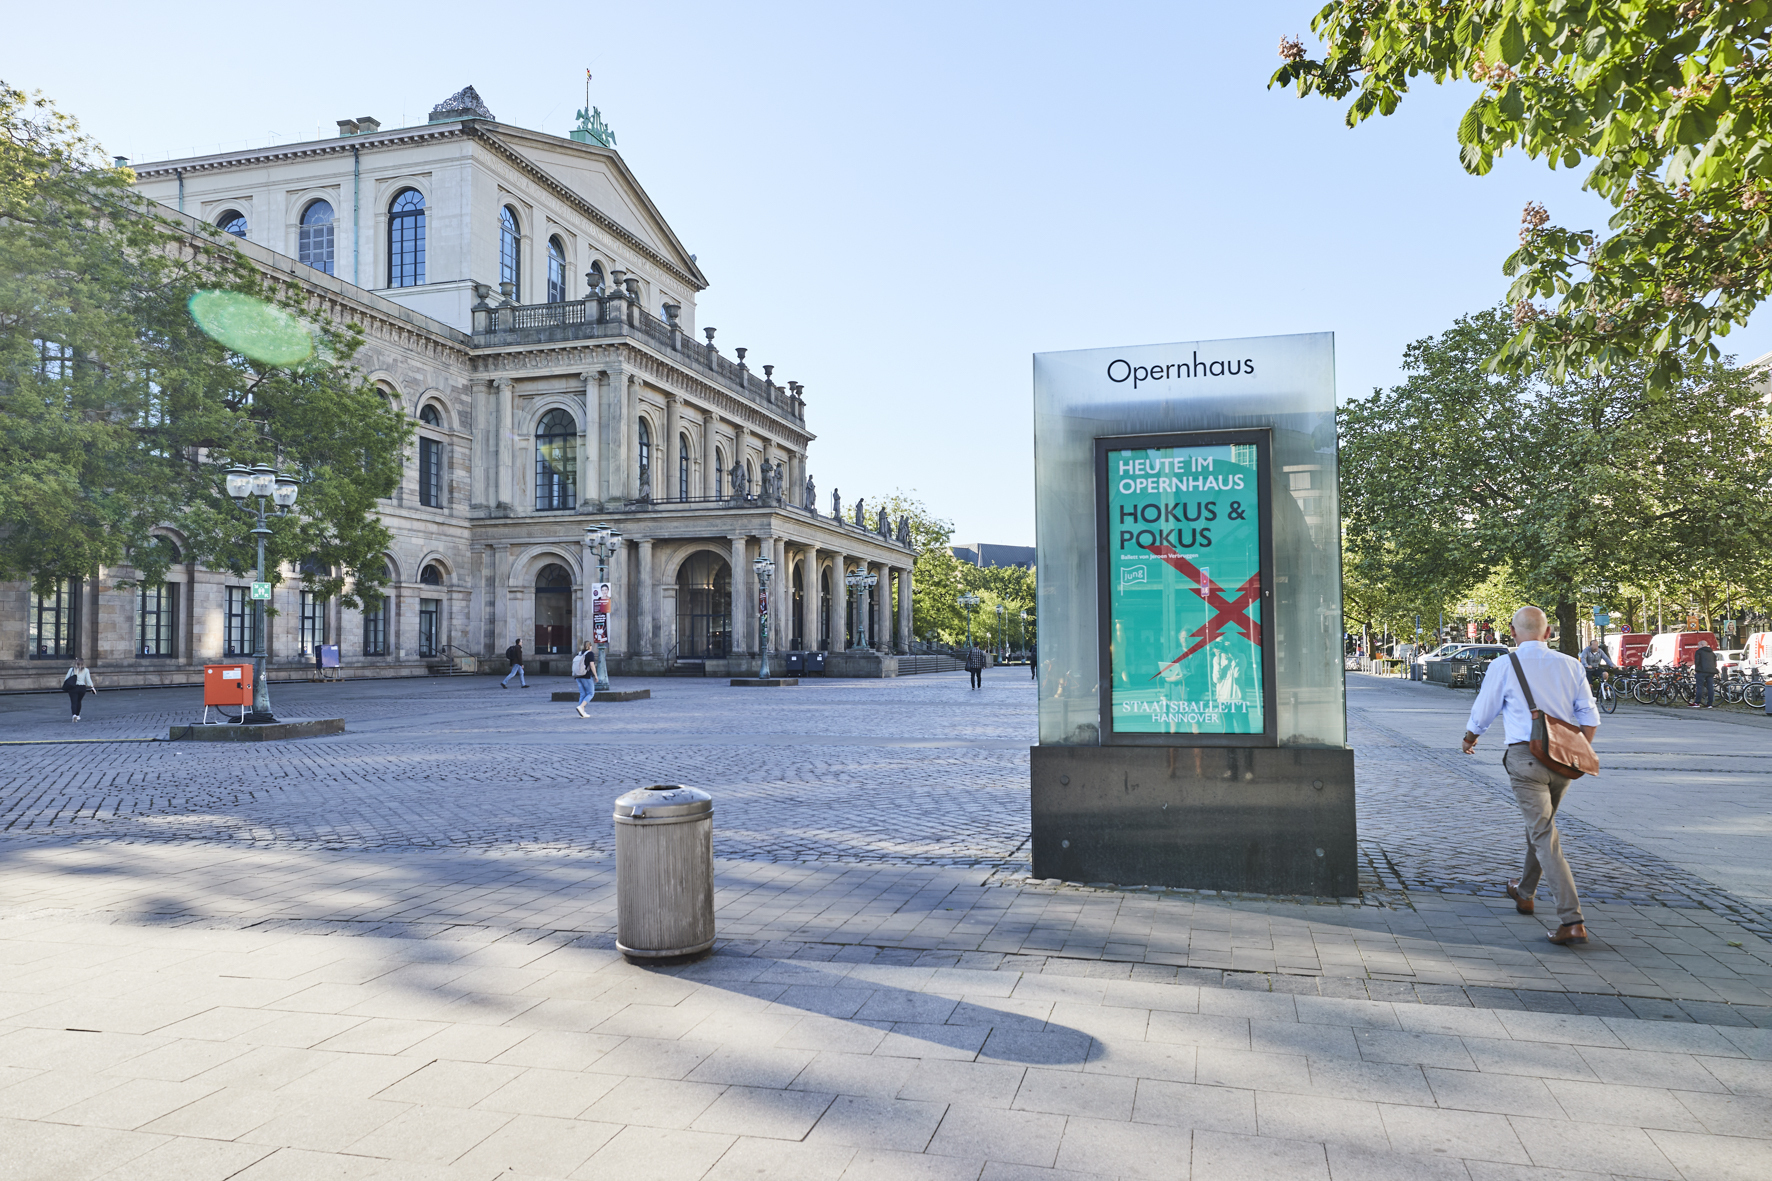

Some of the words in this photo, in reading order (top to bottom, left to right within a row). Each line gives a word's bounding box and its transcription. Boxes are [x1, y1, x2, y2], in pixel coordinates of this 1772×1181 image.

[1107, 351, 1254, 389] Opernhaus
[1119, 458, 1184, 475] HEUTE
[1192, 456, 1213, 472] IM
[1119, 474, 1244, 494] OPERNHAUS
[1119, 501, 1217, 524] HOKUS
[1228, 501, 1246, 520] &
[1120, 528, 1212, 550] POKUS
[1124, 570, 1143, 581] jung
[1122, 700, 1249, 713] STAATSBALLETT
[1152, 713, 1219, 723] HANNOVER
